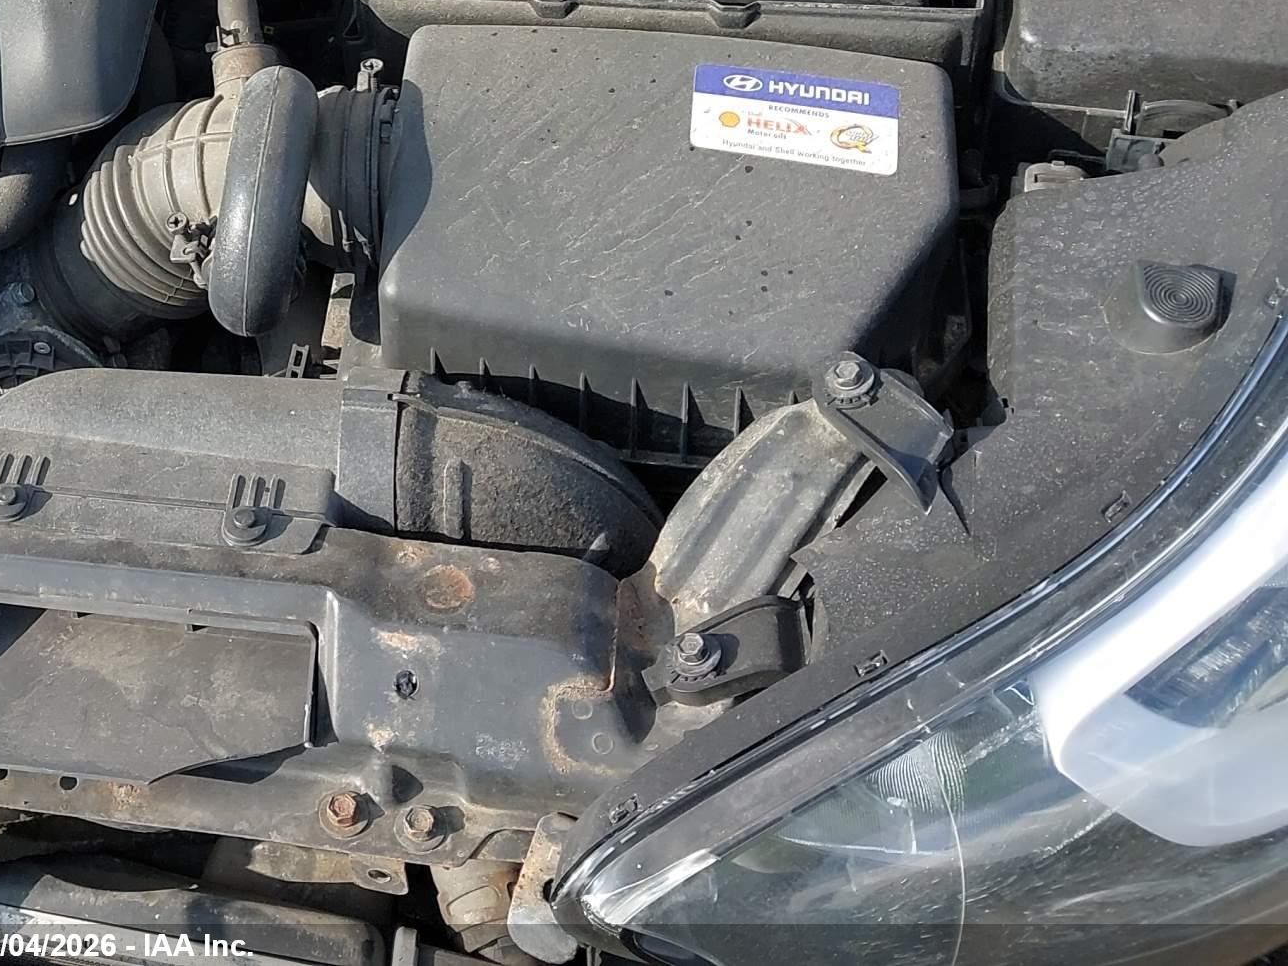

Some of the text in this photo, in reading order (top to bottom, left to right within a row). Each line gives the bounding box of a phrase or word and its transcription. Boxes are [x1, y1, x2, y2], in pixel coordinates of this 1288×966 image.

[769, 80, 870, 106] HYUNDAI
[722, 138, 866, 166] Hyundai and Shell working together
